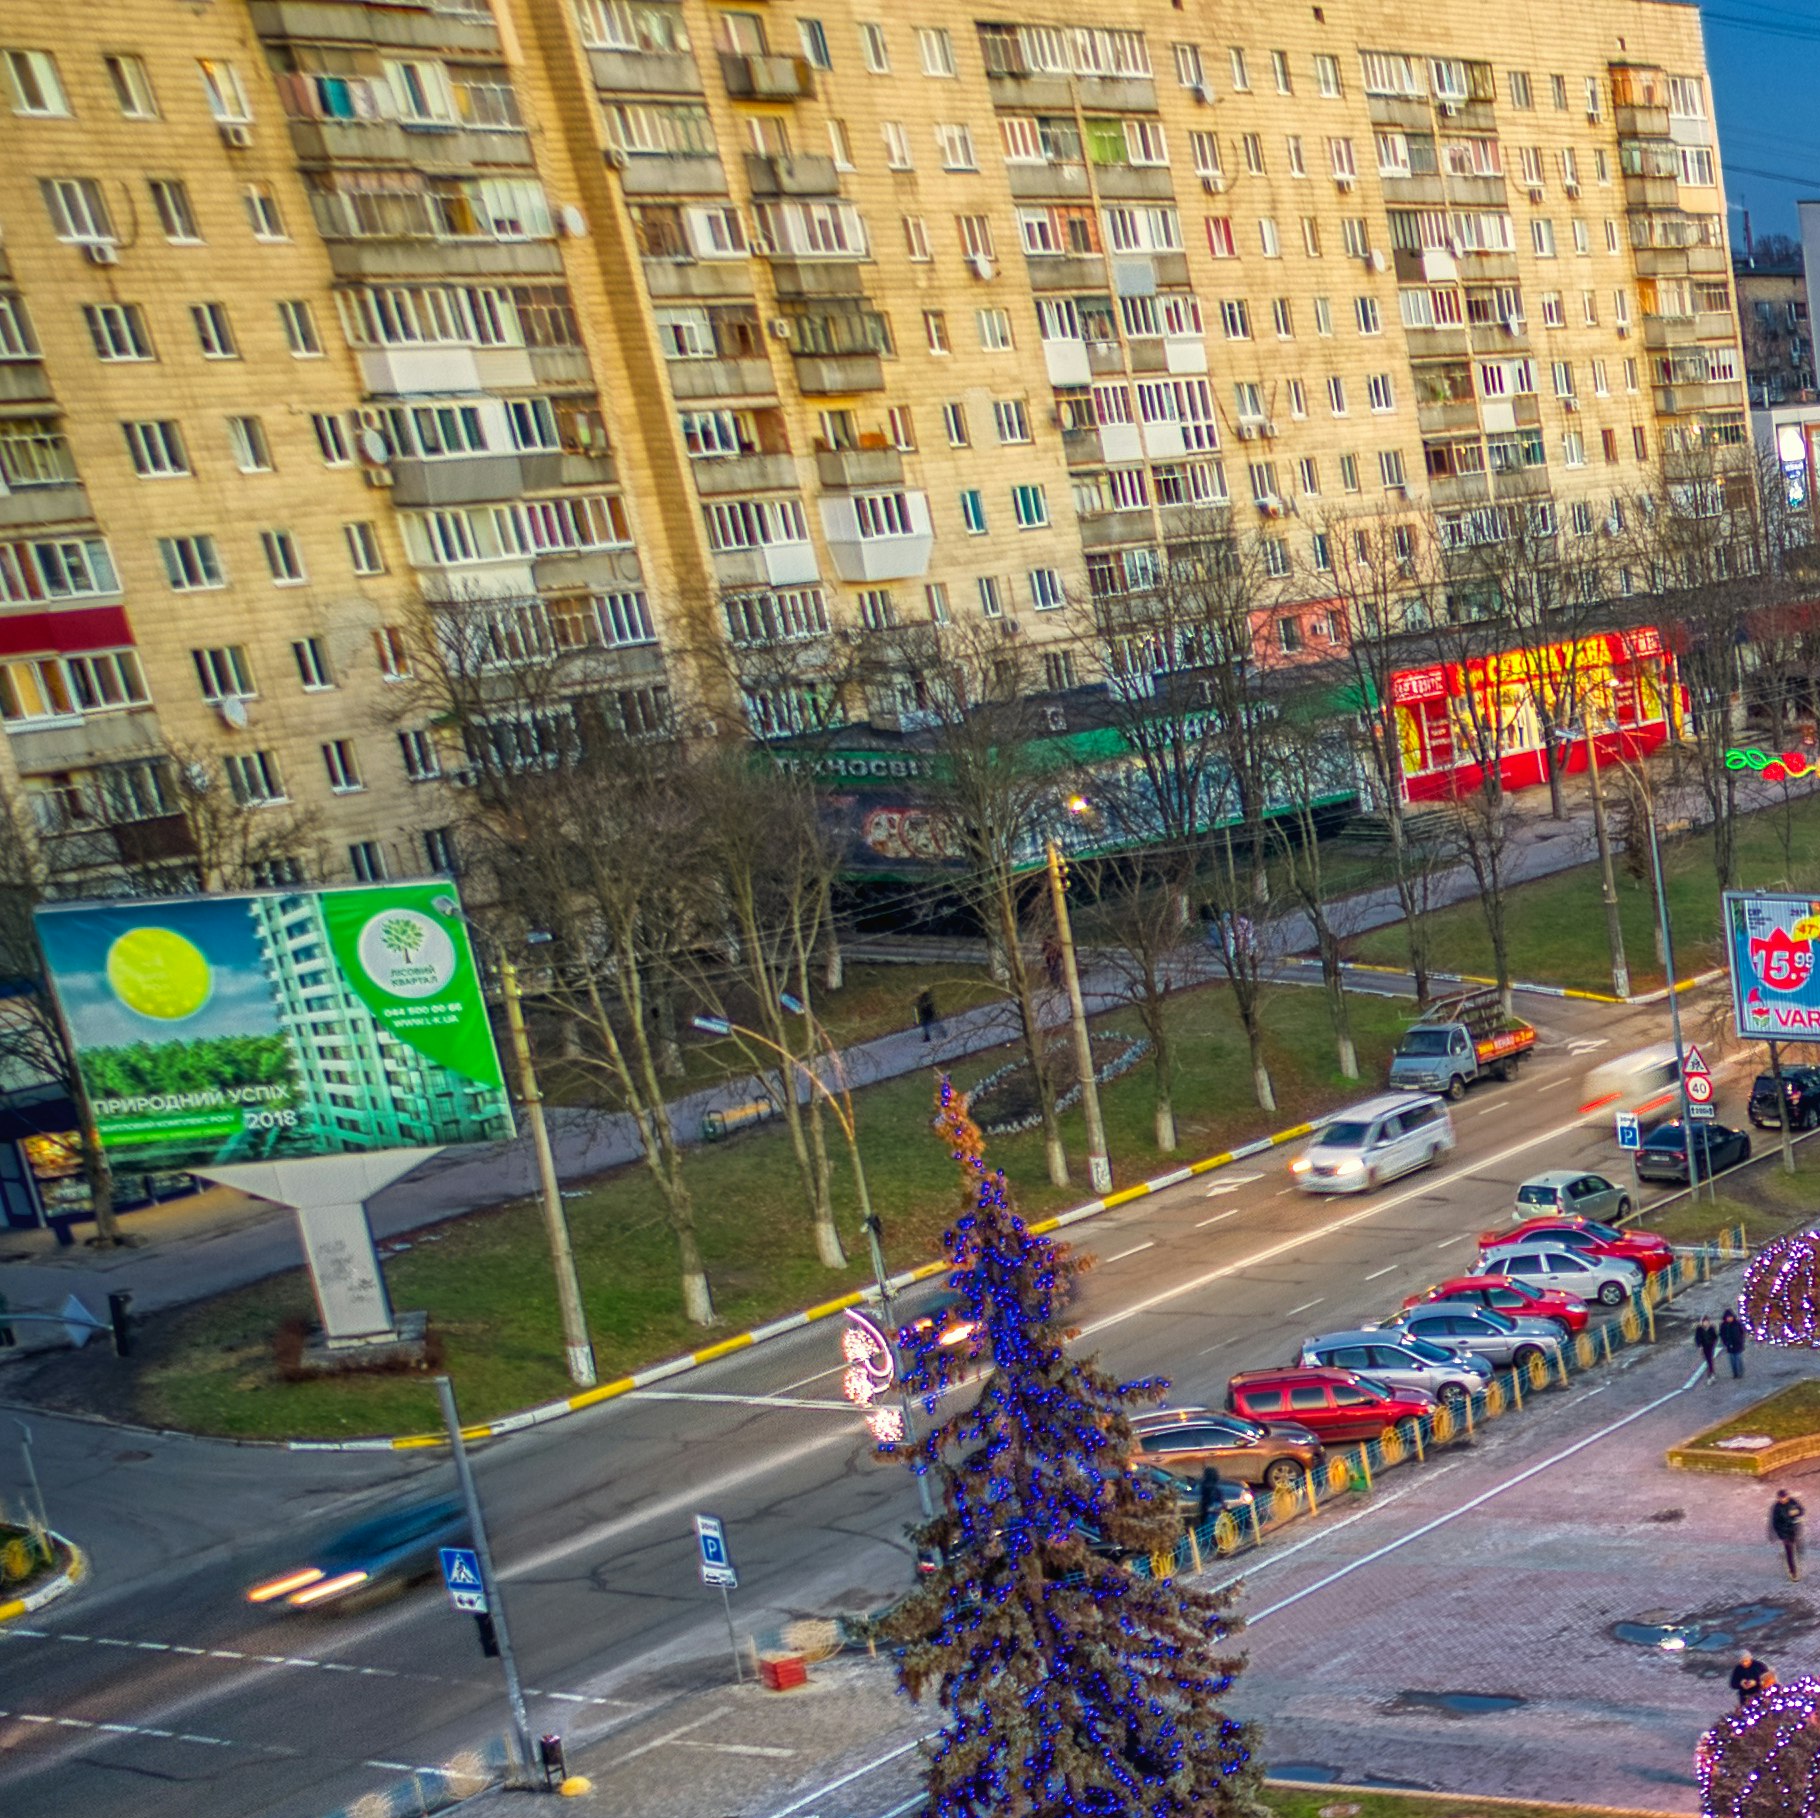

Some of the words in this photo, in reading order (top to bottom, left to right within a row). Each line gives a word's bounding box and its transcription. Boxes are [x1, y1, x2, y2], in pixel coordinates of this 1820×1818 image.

[1692, 1083, 1707, 1094] 40
[92, 1088, 226, 1115] ПРИРОДНИЙ
[227, 1084, 291, 1104] УСПІХ
[244, 1109, 298, 1129] 2018
